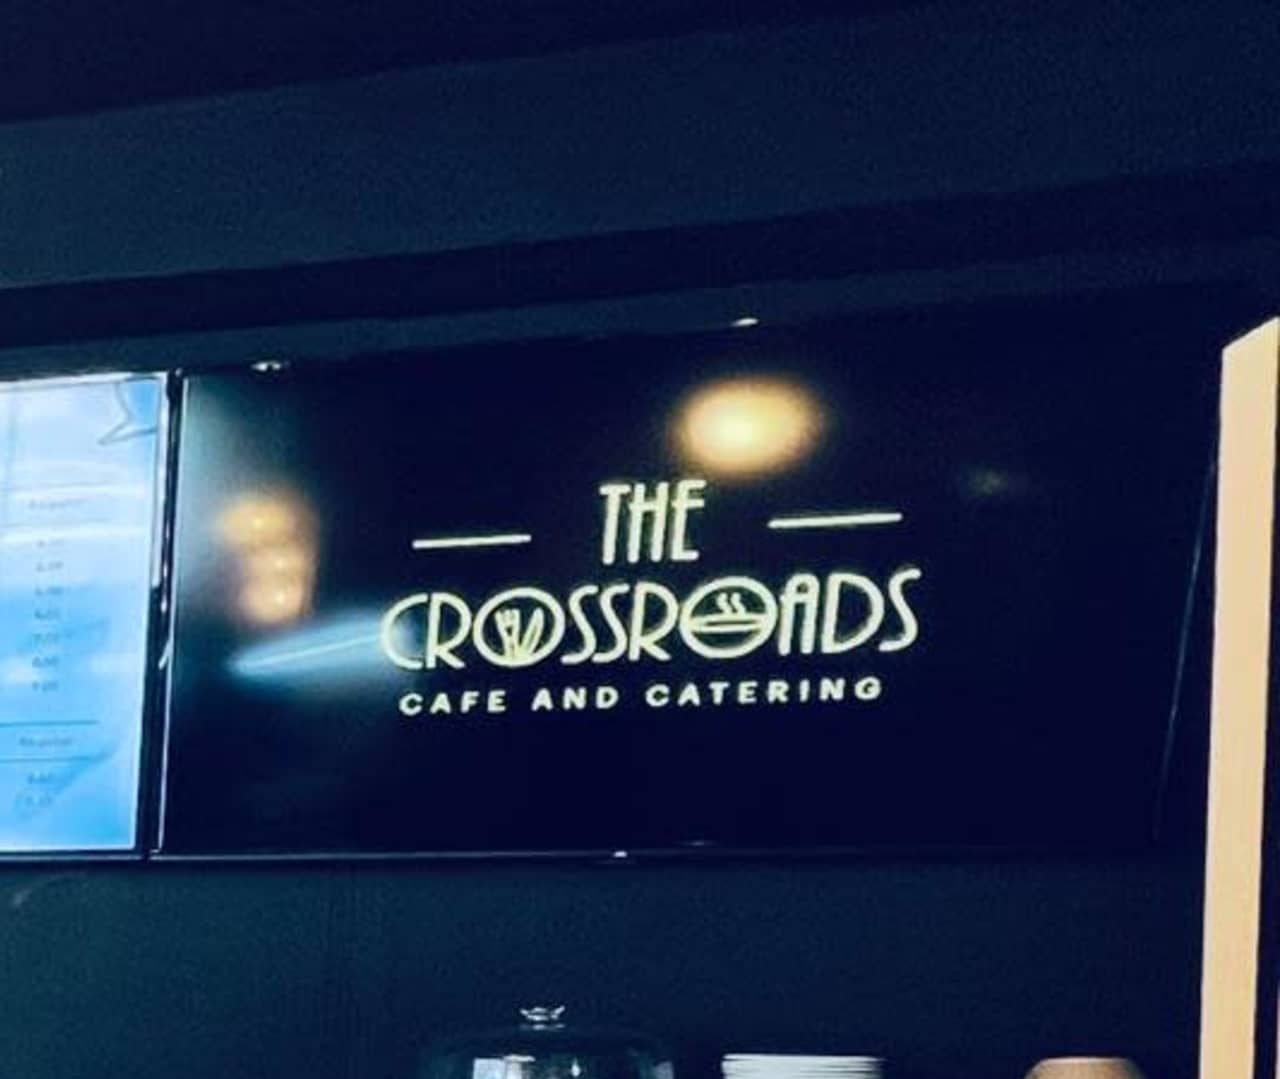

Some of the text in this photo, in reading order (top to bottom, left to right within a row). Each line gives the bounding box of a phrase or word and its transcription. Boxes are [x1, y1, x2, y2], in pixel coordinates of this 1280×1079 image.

[599, 479, 707, 566] THE
[380, 567, 922, 670] CROSSROADS
[399, 676, 883, 715] CAFE AND CATERING
